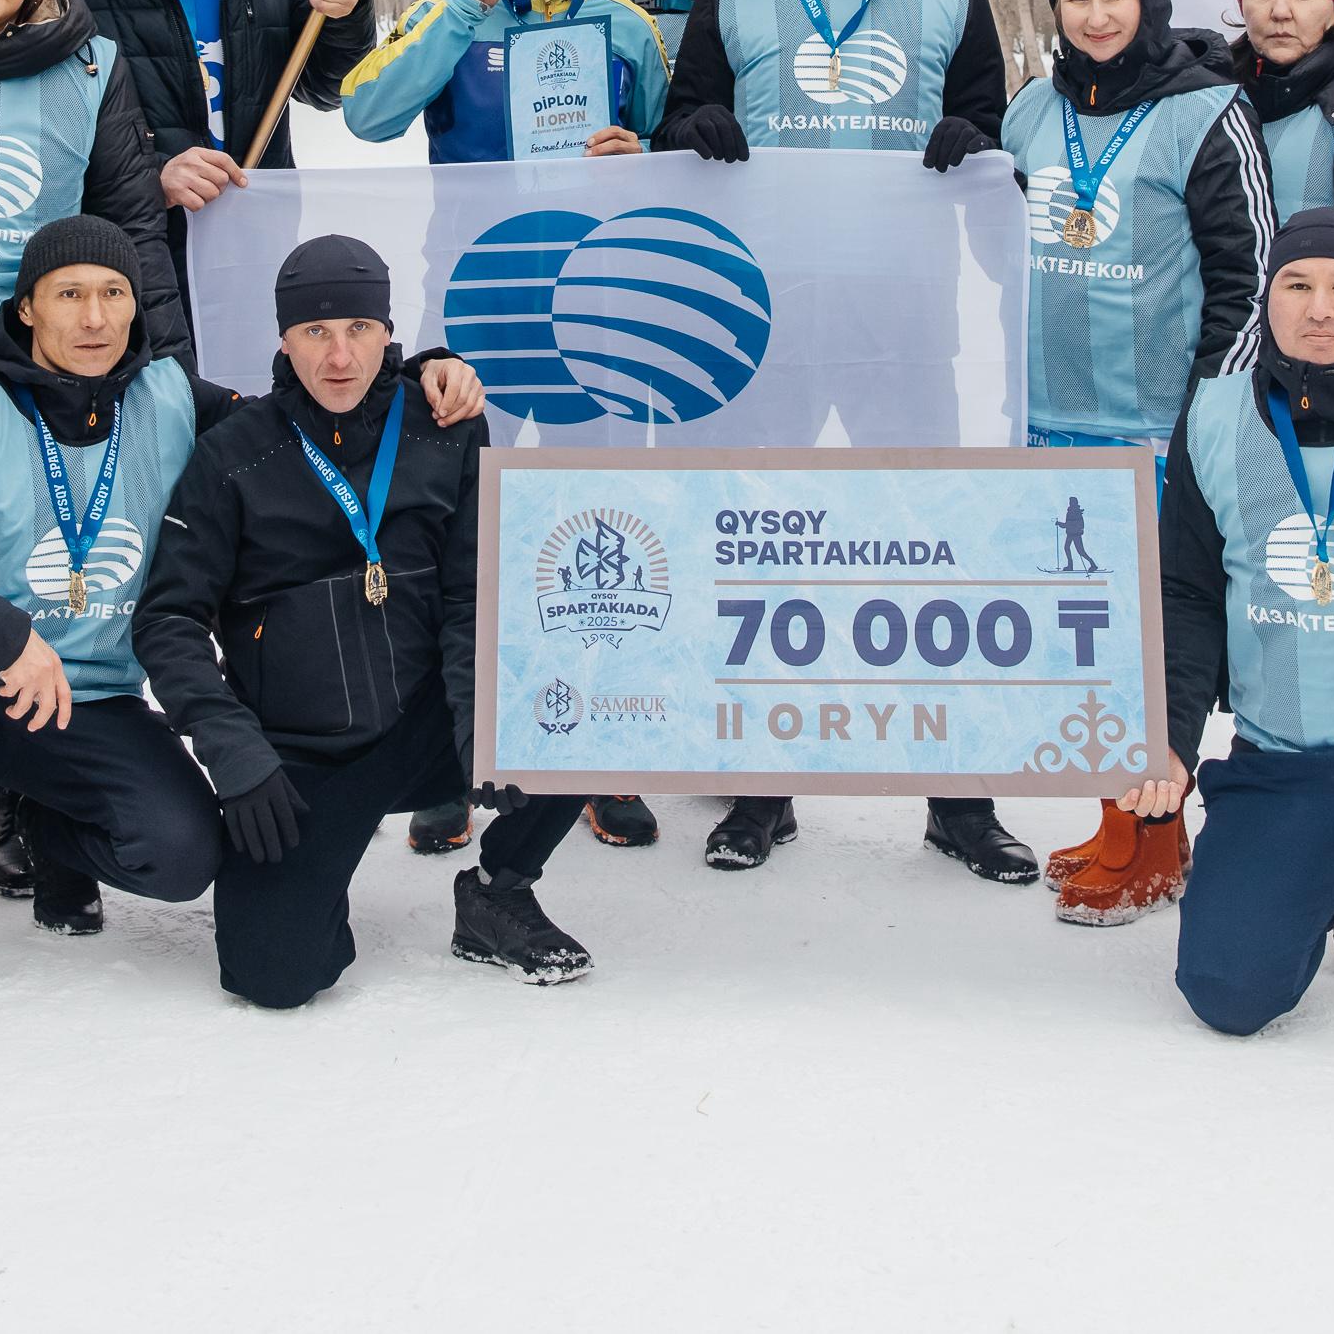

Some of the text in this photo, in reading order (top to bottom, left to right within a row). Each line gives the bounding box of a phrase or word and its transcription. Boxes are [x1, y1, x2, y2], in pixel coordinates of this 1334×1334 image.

[547, 110, 587, 127] ORYN
[768, 115, 927, 135] ҚАЗАҚТЕЛЕКОМ
[1069, 141, 1085, 169] QYSQY
[1100, 135, 1124, 166] QYSQY
[89, 401, 120, 521] QYSQY SPARTAKIADA
[53, 484, 71, 521] QYSQY
[332, 482, 359, 515] QYSQY
[714, 509, 828, 537] QYSQY
[714, 540, 957, 566] SPARTAKIADA
[546, 602, 660, 618] SPARTAKIADA
[586, 616, 618, 627] 2025
[716, 598, 827, 667] 70
[852, 598, 1034, 667] 000
[590, 696, 667, 712] SAMRUK
[590, 713, 668, 722] KAZYNA
[715, 702, 949, 742] II ORYN
